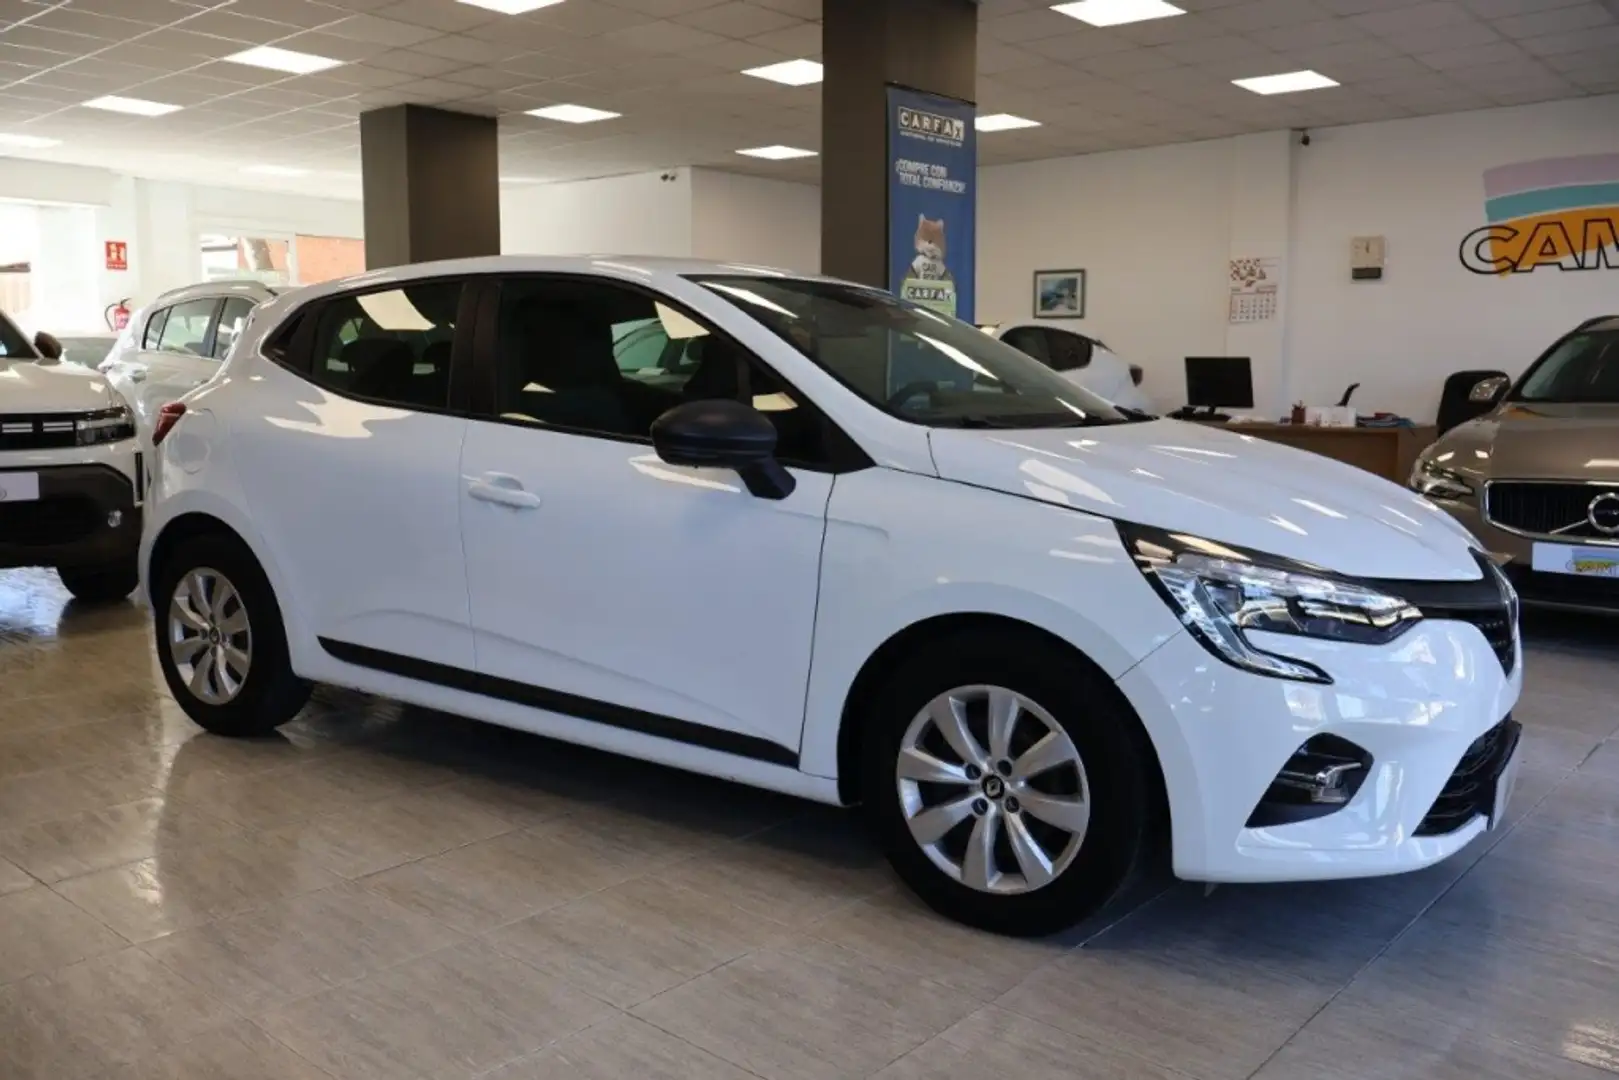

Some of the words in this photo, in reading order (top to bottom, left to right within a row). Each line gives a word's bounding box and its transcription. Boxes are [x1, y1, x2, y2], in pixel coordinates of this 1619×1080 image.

[899, 107, 964, 141] CARFAX
[930, 164, 947, 178] CON
[899, 172, 922, 188] TOTAL
